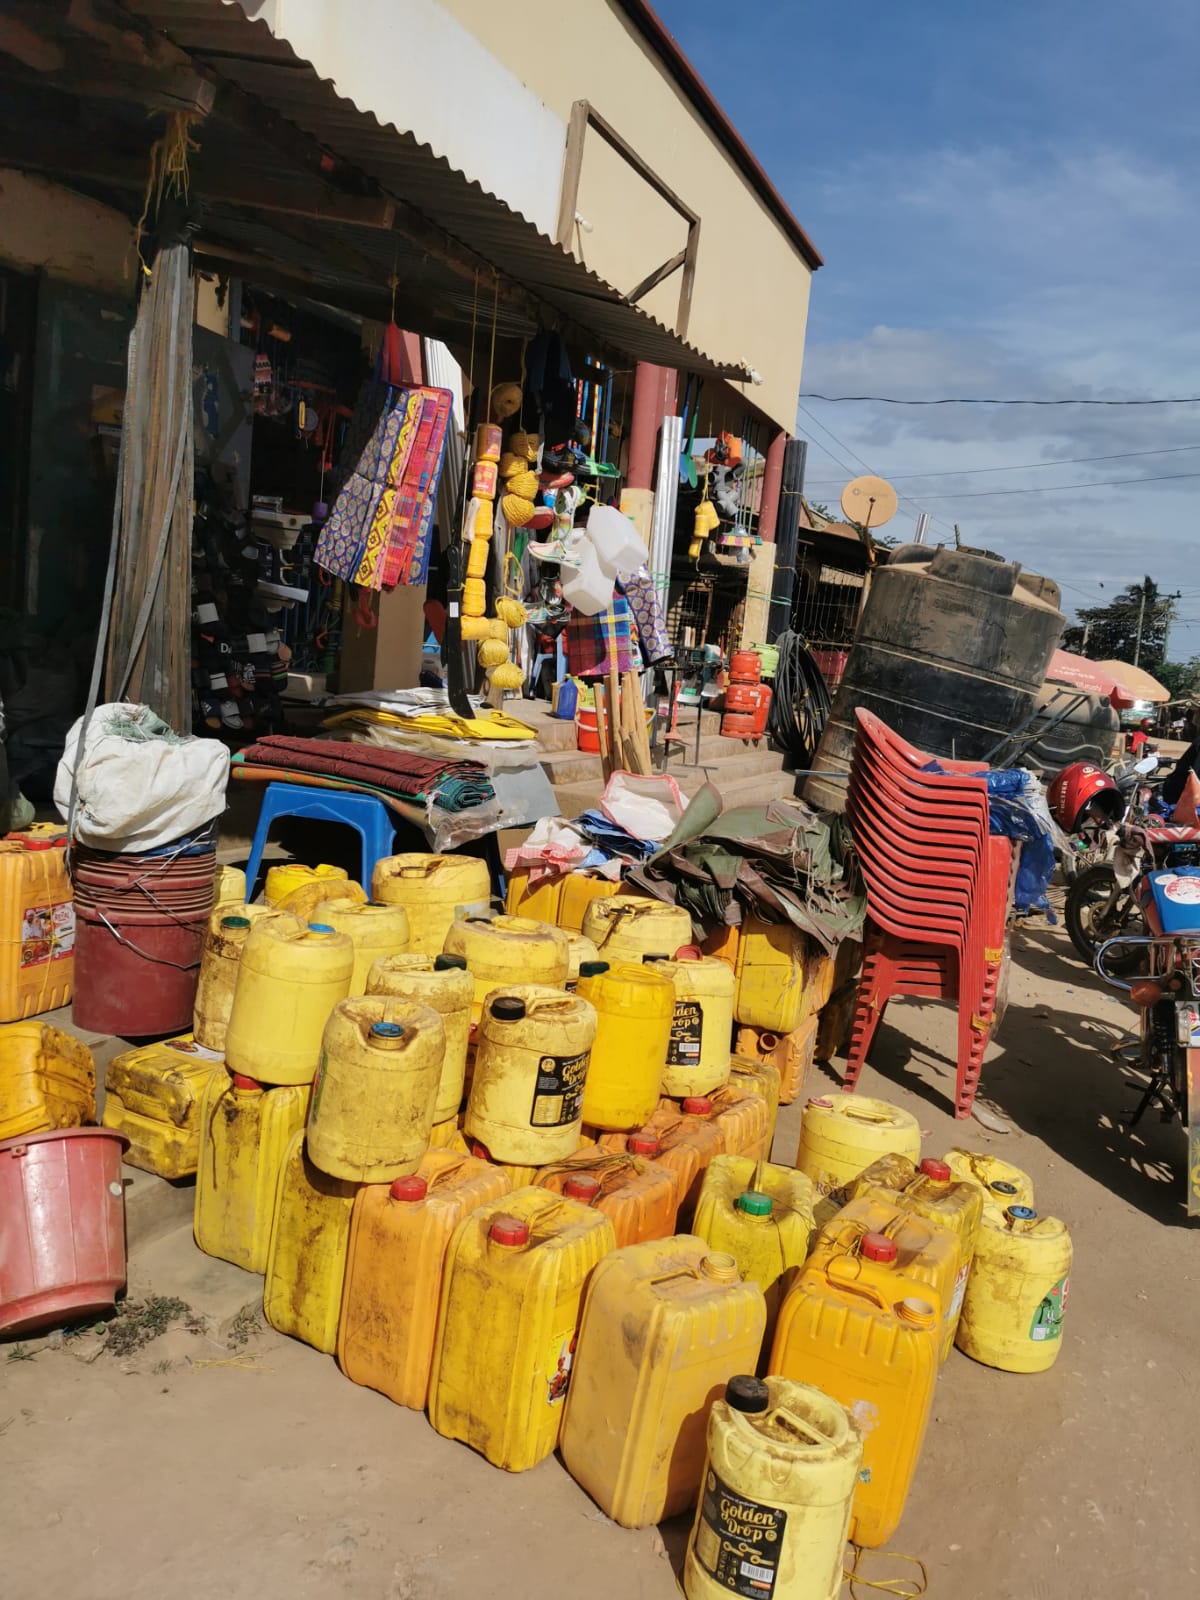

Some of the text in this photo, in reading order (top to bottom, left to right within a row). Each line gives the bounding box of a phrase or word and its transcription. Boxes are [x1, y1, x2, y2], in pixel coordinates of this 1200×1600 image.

[673, 1006, 699, 1018] lden
[672, 1018, 691, 1029] rop
[720, 1499, 777, 1528] Golden
[726, 1518, 763, 1543] Drop
